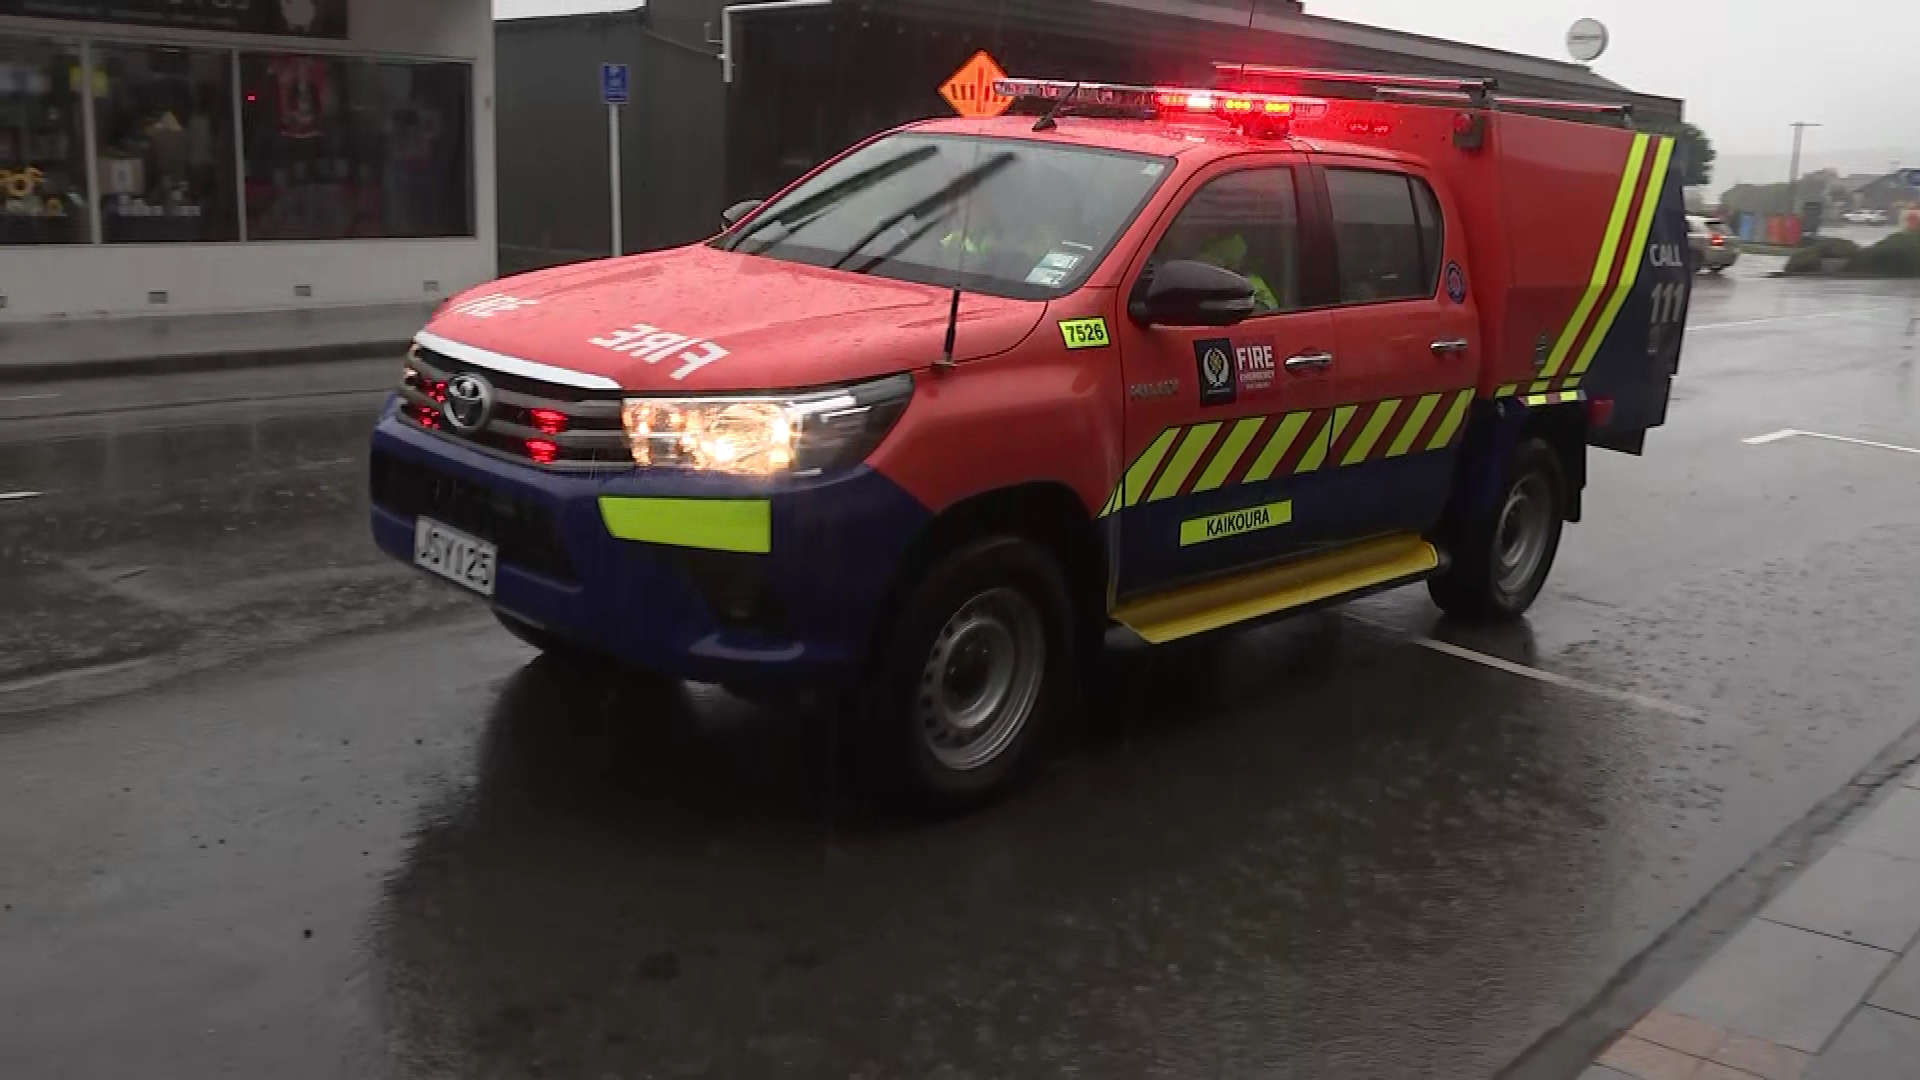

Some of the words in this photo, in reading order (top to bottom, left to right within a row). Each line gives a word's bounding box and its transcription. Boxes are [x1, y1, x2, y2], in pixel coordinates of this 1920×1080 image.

[1649, 243, 1683, 267] CALL
[1650, 283, 1685, 323] 111
[1065, 323, 1104, 342] 7526
[1236, 345, 1274, 371] FIRE
[1206, 507, 1270, 536] KAIKOURA
